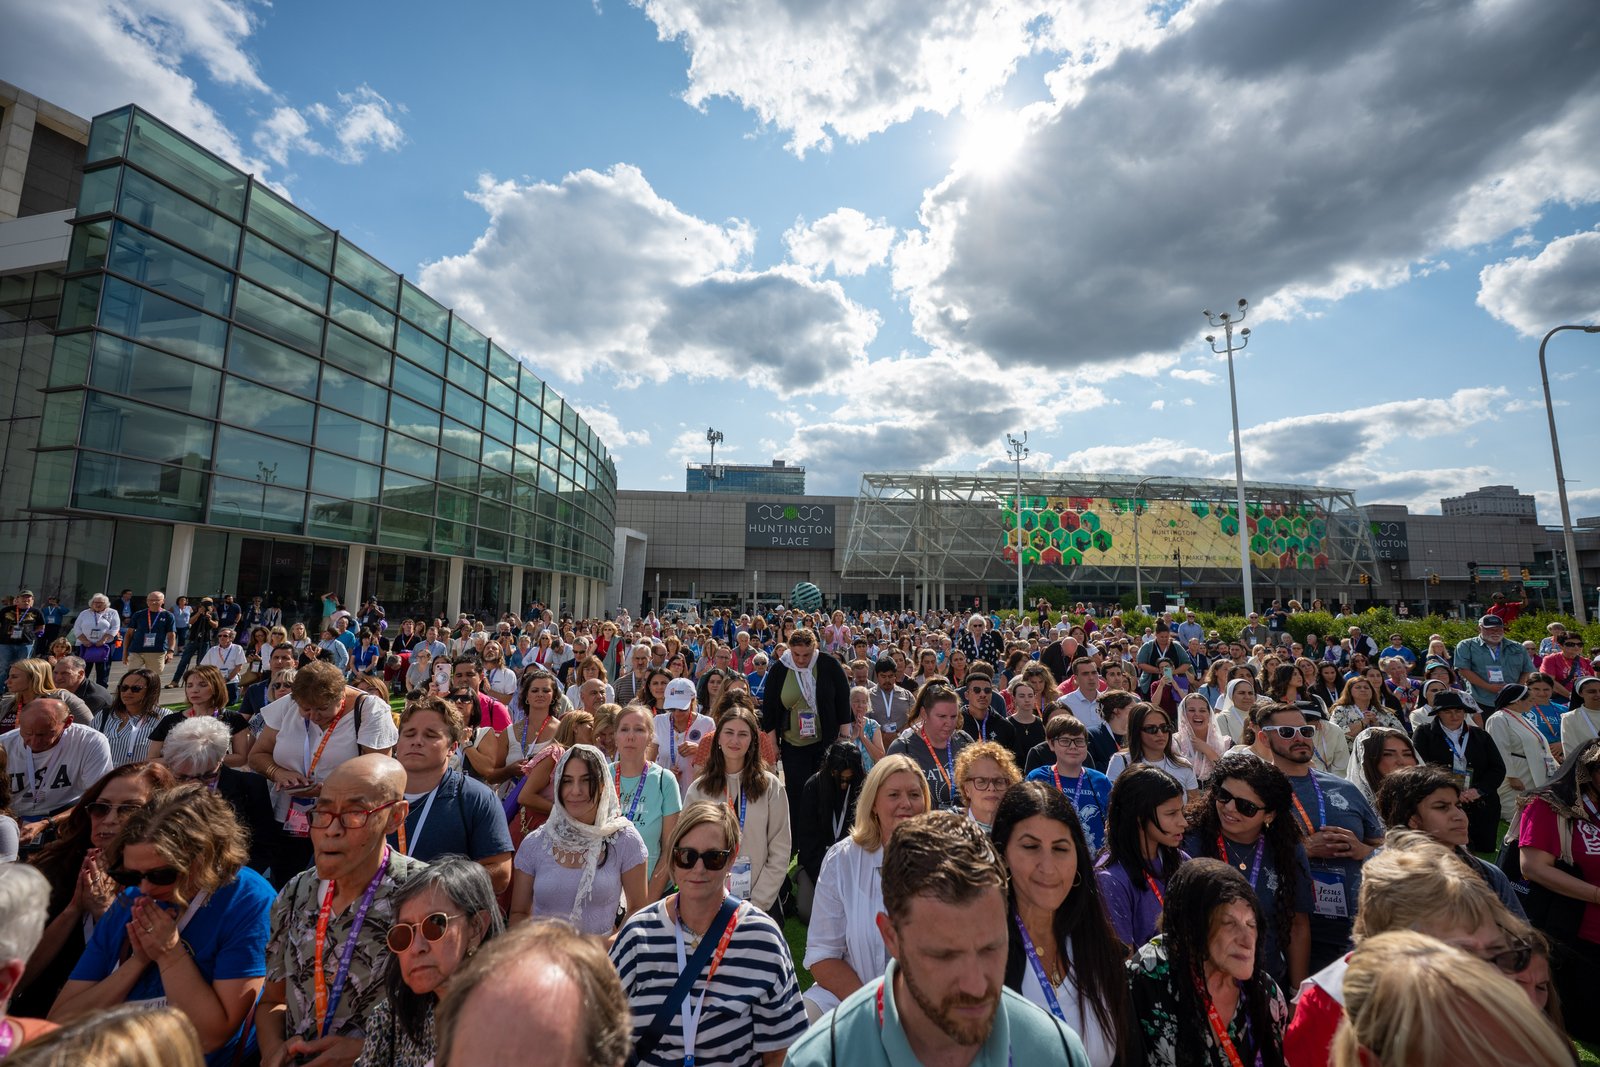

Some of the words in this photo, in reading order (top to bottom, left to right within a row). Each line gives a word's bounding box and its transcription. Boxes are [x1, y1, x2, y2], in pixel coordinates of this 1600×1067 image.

[749, 524, 832, 534] HUNTINGTON
[772, 536, 809, 546] PLACE
[1318, 886, 1341, 896] Jesus
[1319, 894, 1342, 903] Leads
